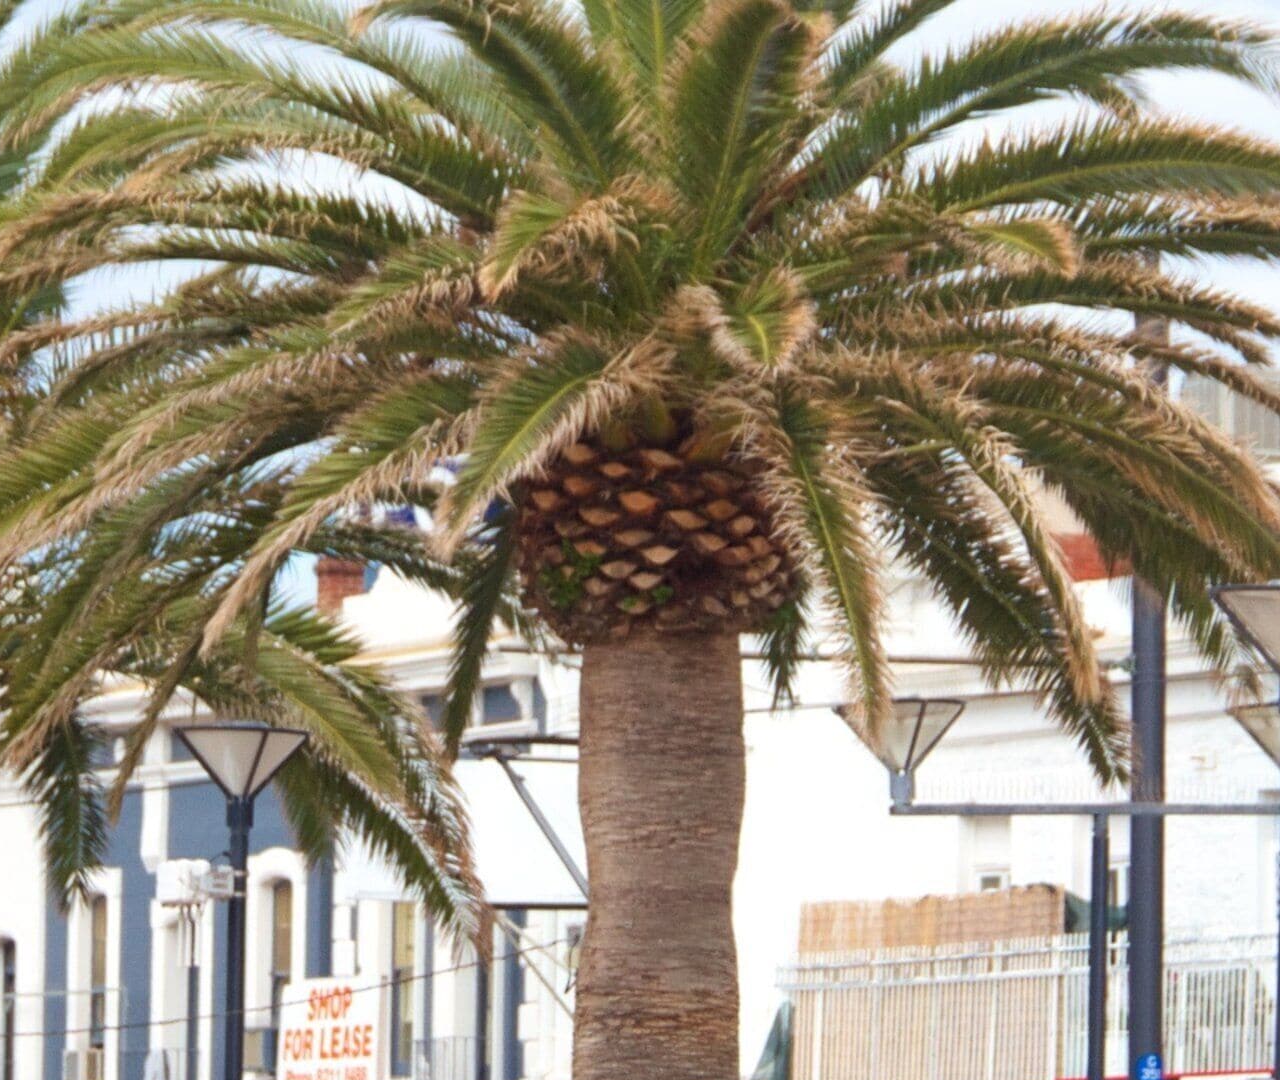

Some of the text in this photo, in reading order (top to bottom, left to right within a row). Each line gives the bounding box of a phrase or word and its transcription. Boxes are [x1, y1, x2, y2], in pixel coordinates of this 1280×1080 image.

[308, 986, 353, 1021] SHOP
[284, 1024, 373, 1061] FOR LEASE
